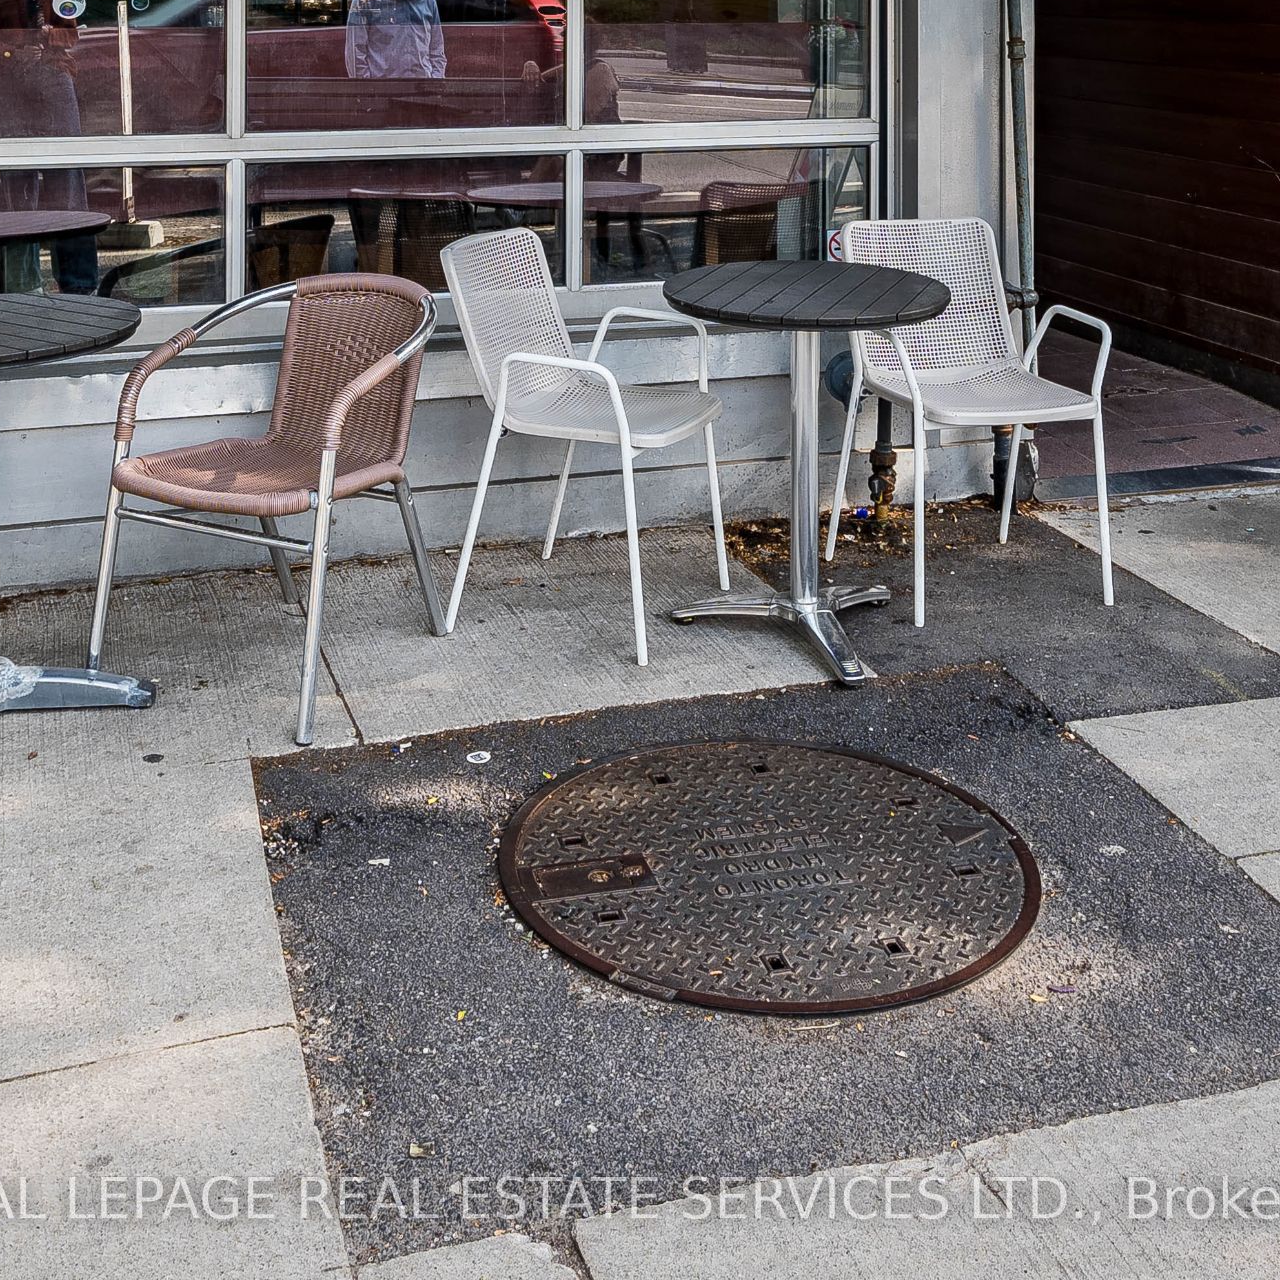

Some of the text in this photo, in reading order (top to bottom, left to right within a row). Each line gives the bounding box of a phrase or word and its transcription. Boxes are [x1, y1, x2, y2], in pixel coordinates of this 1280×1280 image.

[694, 816, 809, 841] SYSTEM
[693, 832, 830, 861] ELECTRIC
[723, 852, 826, 876] HYDRO
[713, 870, 854, 900] TORONTO
